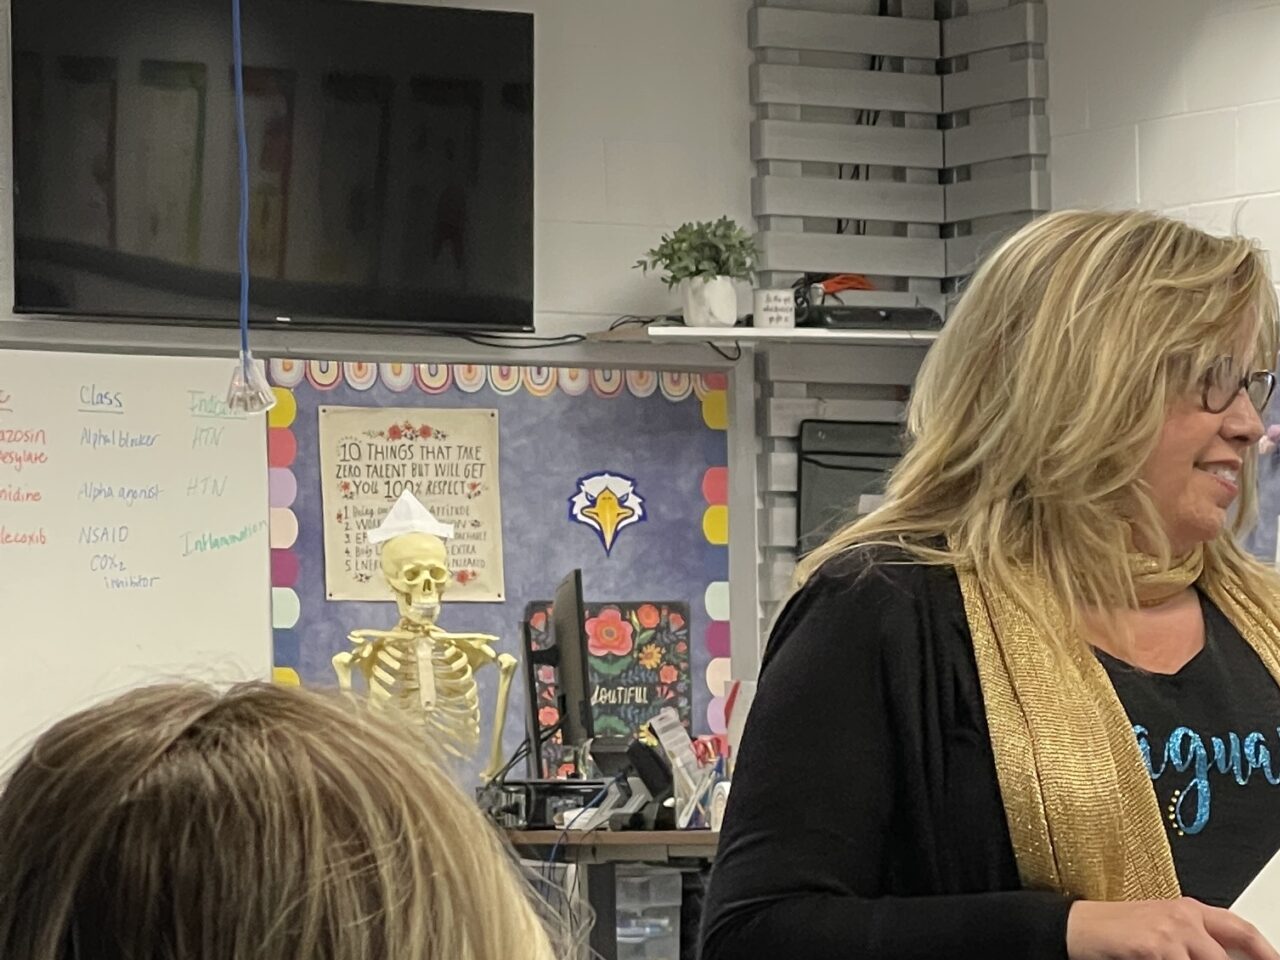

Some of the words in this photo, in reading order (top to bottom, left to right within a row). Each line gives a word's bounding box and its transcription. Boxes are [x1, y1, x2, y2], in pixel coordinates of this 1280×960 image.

[79, 384, 123, 408] Class
[192, 427, 224, 449] HTN
[340, 442, 361, 462] 10
[367, 443, 414, 461] THINGS
[420, 445, 452, 461] THAT
[456, 445, 482, 461] TAKE
[336, 464, 361, 478] ZERO
[366, 463, 408, 478] TALENT
[412, 463, 430, 478] BUT
[434, 463, 460, 478] WILL
[464, 463, 486, 478] GET
[78, 481, 114, 503] Alpha
[118, 482, 163, 508] agonist
[187, 475, 228, 498] HTN
[353, 481, 379, 494] YOU
[384, 480, 425, 498] 100%
[426, 481, 466, 495] RESPECT
[78, 526, 129, 545] NSAID
[344, 522, 350, 532] 2
[182, 519, 268, 557] Inflammation
[451, 545, 476, 555] EXTRA
[345, 560, 351, 572] 5
[104, 575, 160, 590] inhibitor
